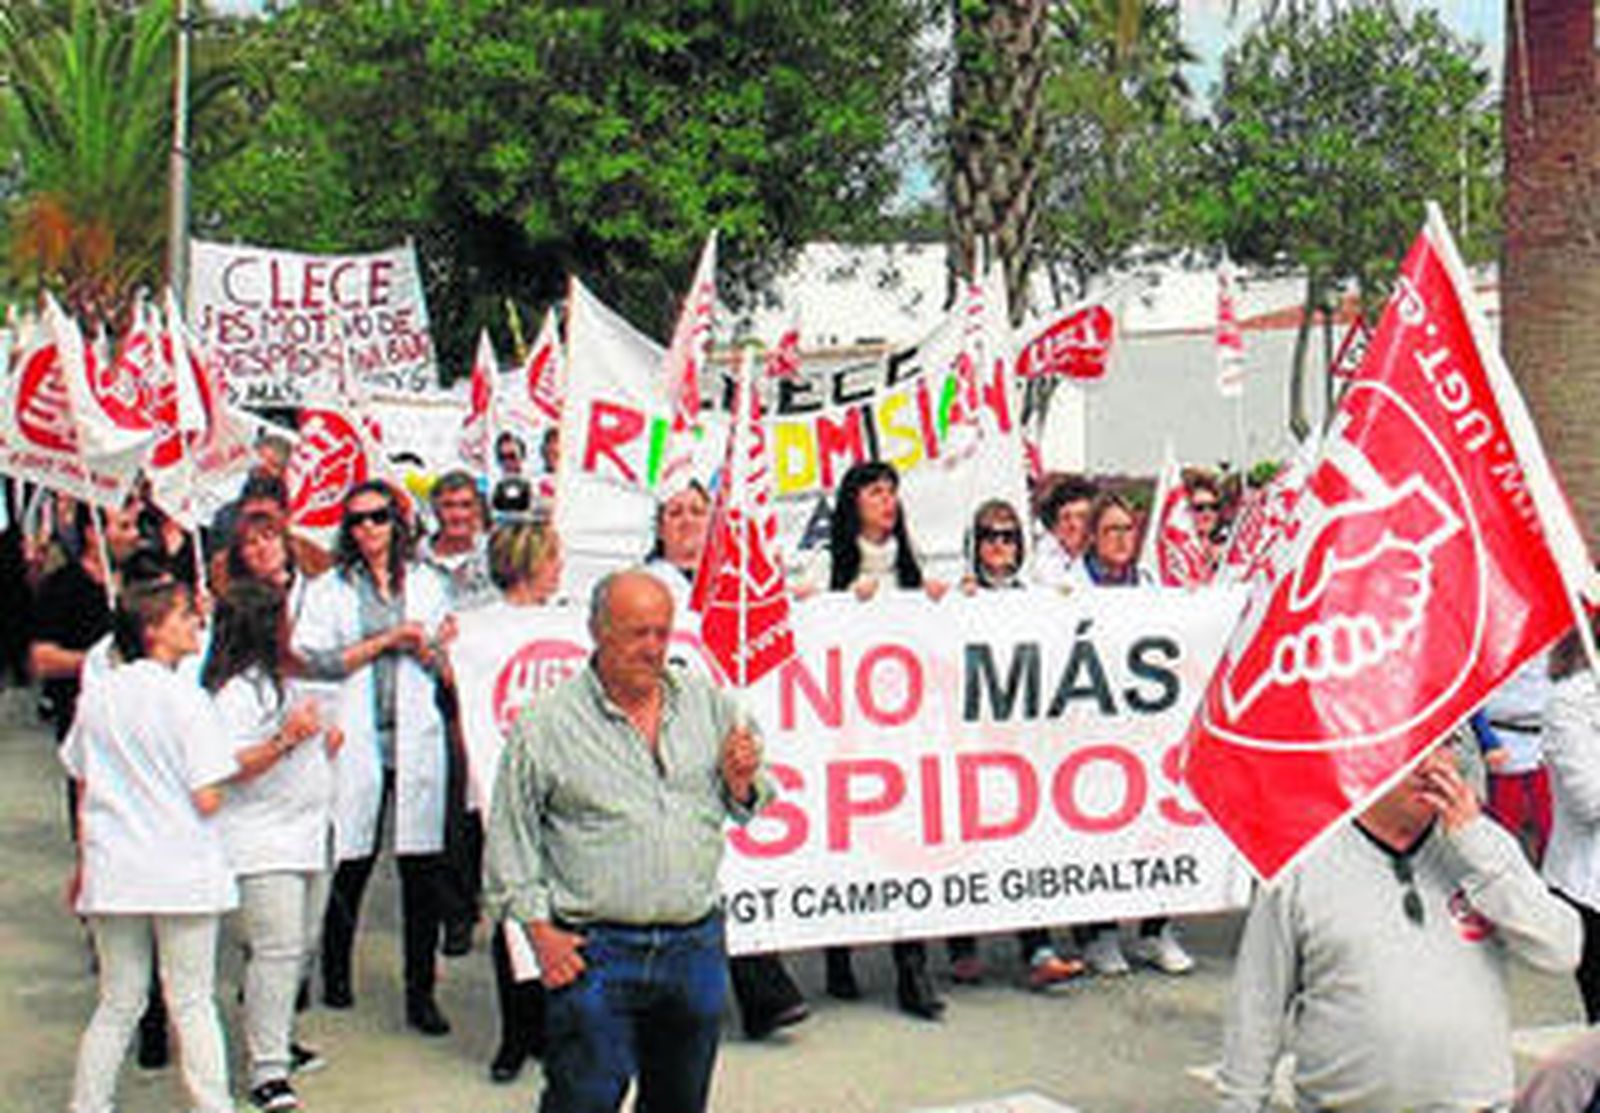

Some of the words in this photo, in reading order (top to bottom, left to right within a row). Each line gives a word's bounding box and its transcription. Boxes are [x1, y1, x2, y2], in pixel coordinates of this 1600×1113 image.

[222, 256, 393, 311] CLECE
[779, 643, 924, 731] NO
[962, 620, 1182, 722] MÁS
[718, 888, 779, 923] GT
[791, 877, 932, 920] CAMPO
[943, 872, 990, 907] DE
[1000, 854, 1200, 902] GIBRALTAR
